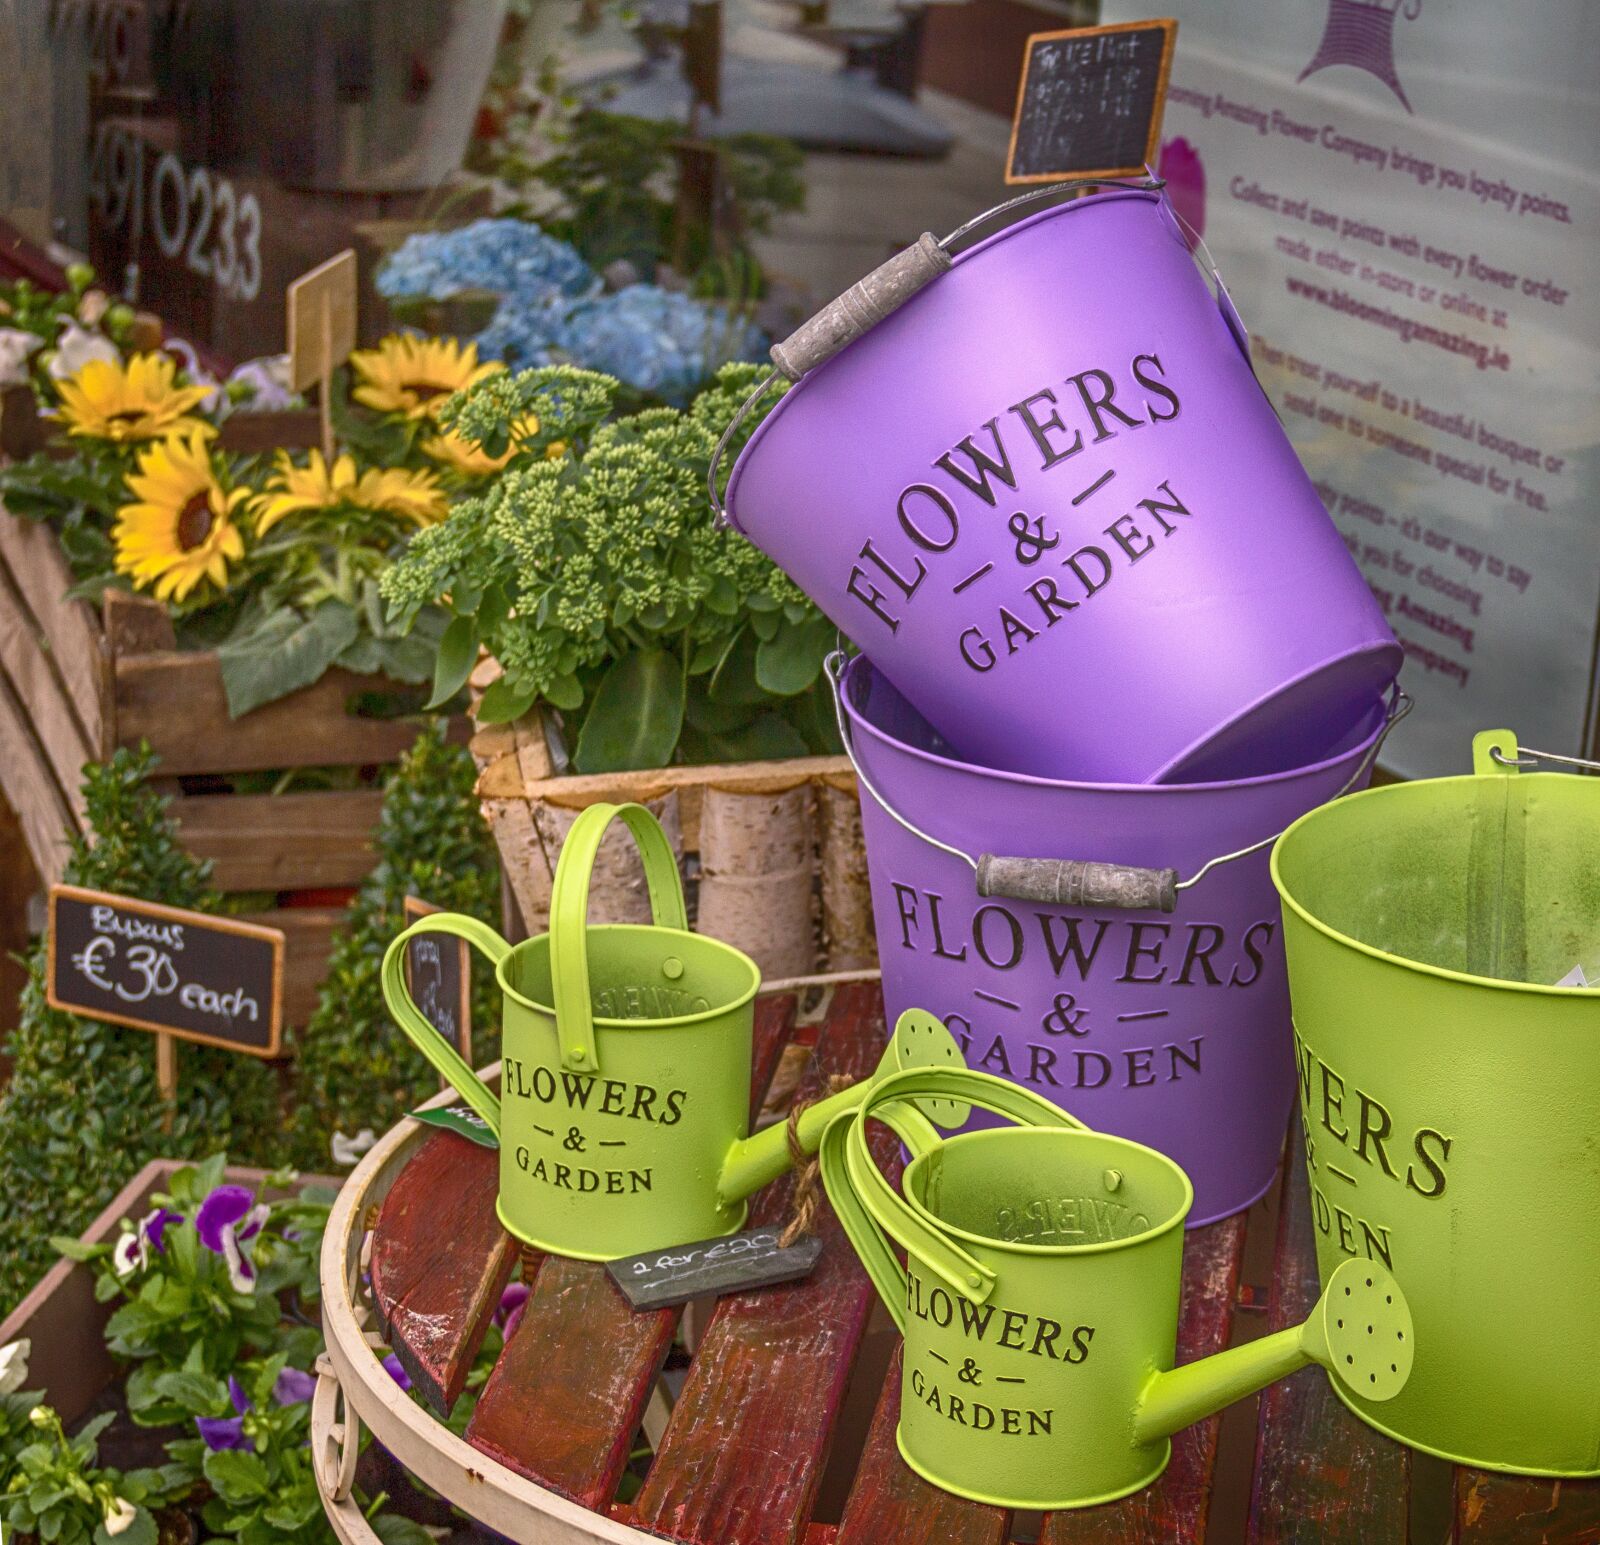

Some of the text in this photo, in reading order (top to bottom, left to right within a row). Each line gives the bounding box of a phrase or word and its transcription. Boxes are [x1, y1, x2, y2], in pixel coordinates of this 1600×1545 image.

[1214, 93, 1269, 136] Amazing
[1271, 109, 1318, 143] Flower
[1320, 124, 1389, 172] Company
[1391, 146, 1436, 186] brings
[1437, 167, 1466, 190] you
[1468, 170, 1518, 212] loyalty
[1518, 192, 1572, 224] points.
[1230, 175, 1569, 306] Collect and save points with every flower order
[1275, 235, 1508, 329] made either in-store or online at
[1285, 276, 1511, 372] www.bloomingamazing.ie
[1251, 334, 1286, 367] Then
[1321, 371, 1382, 404] yourself
[1381, 389, 1399, 412] to
[1400, 398, 1410, 416] a
[1413, 398, 1475, 441] beautiful
[1478, 424, 1541, 468] bouquet
[1544, 455, 1566, 474] or
[1283, 391, 1318, 418] send
[1318, 404, 1346, 431] one
[1347, 415, 1365, 438] to
[1365, 424, 1432, 466] someone
[1435, 452, 1486, 486] special
[1487, 466, 1510, 494] for
[846, 353, 1182, 634] FLOWERS
[959, 480, 1193, 673] GARDEN
[1008, 510, 1060, 566] &
[1339, 494, 1385, 527] points
[1422, 529, 1452, 553] our
[1454, 544, 1485, 573] way
[1486, 554, 1505, 577] to
[1506, 564, 1532, 594] say
[1361, 544, 1390, 570] you
[1391, 550, 1415, 577] for
[1416, 565, 1483, 617] choosing
[1391, 628, 1471, 690] ompany
[1396, 593, 1475, 653] Amazing
[90, 905, 186, 951] Buxus
[891, 880, 1278, 988] FLOWERS
[71, 936, 260, 1022] €30 each
[1042, 992, 1091, 1037] &
[505, 1057, 688, 1126] FLOWERS
[516, 1145, 653, 1195] GARDEN
[563, 1126, 588, 1154] &
[907, 1269, 1096, 1365] FLOWERS
[912, 1368, 1054, 1436] GARDEN
[957, 1357, 983, 1387] &
